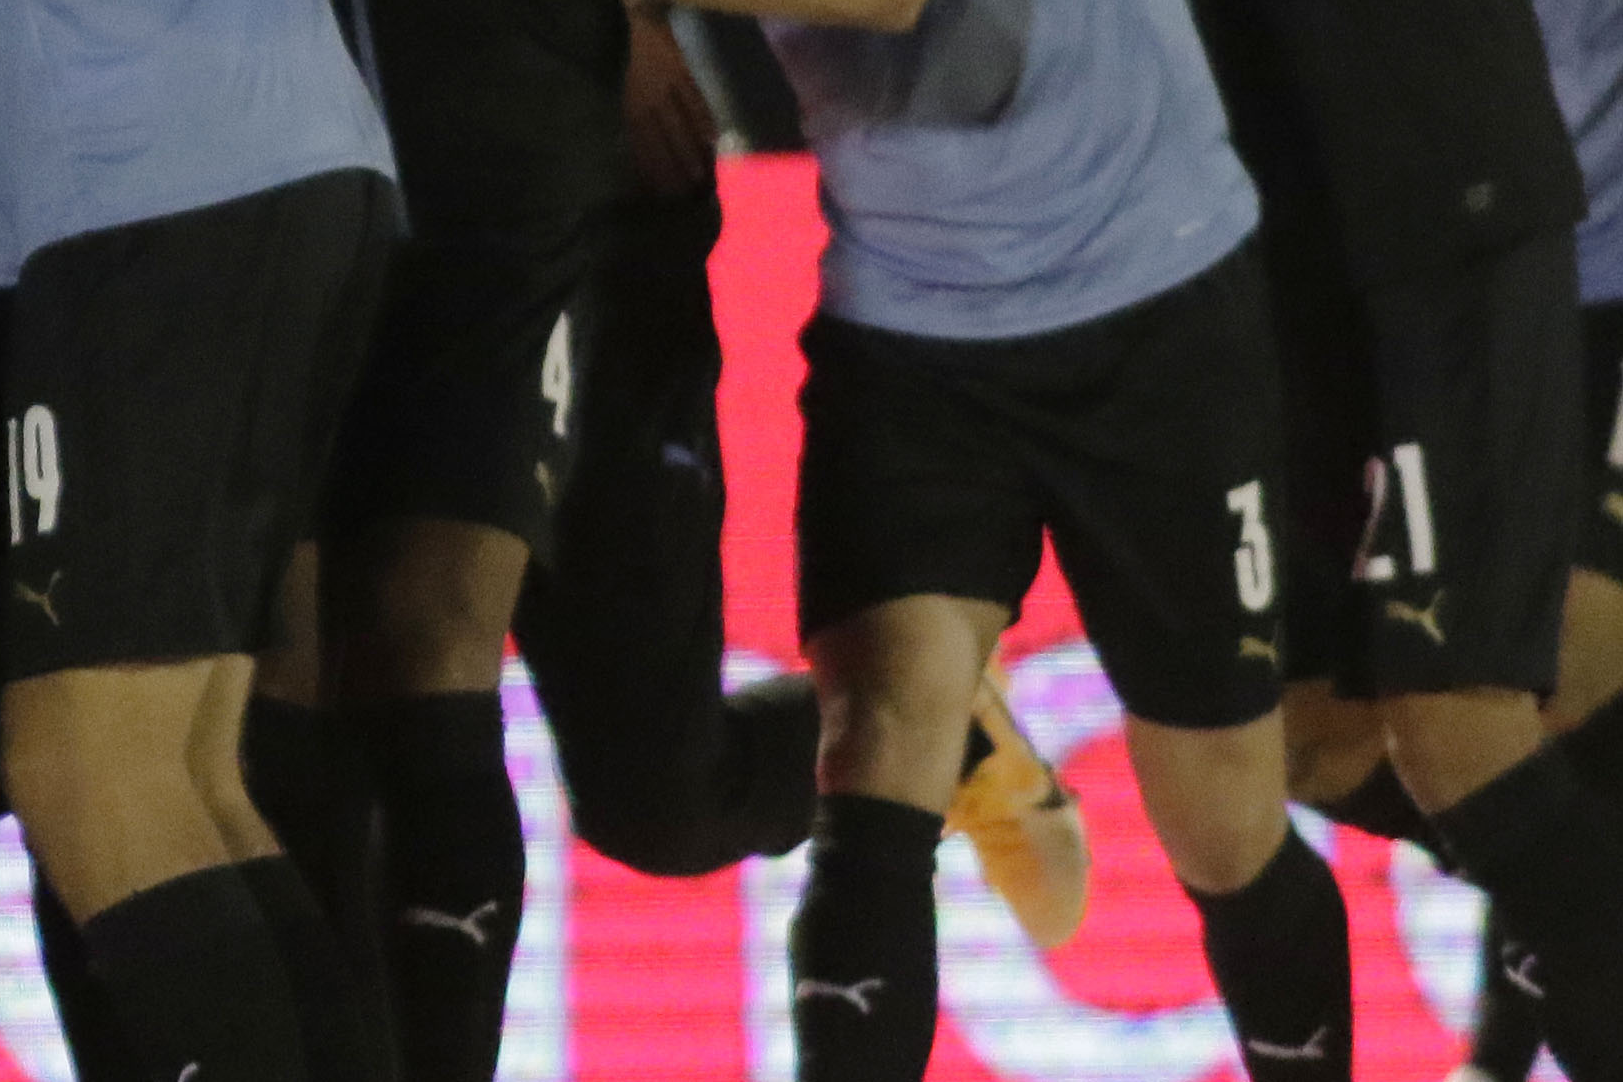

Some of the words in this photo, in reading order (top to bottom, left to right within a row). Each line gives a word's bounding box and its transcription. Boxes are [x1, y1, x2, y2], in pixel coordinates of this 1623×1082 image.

[540, 309, 572, 438] 4
[6, 404, 62, 545] 19
[1352, 440, 1437, 582] 21
[1225, 480, 1274, 612] 3
